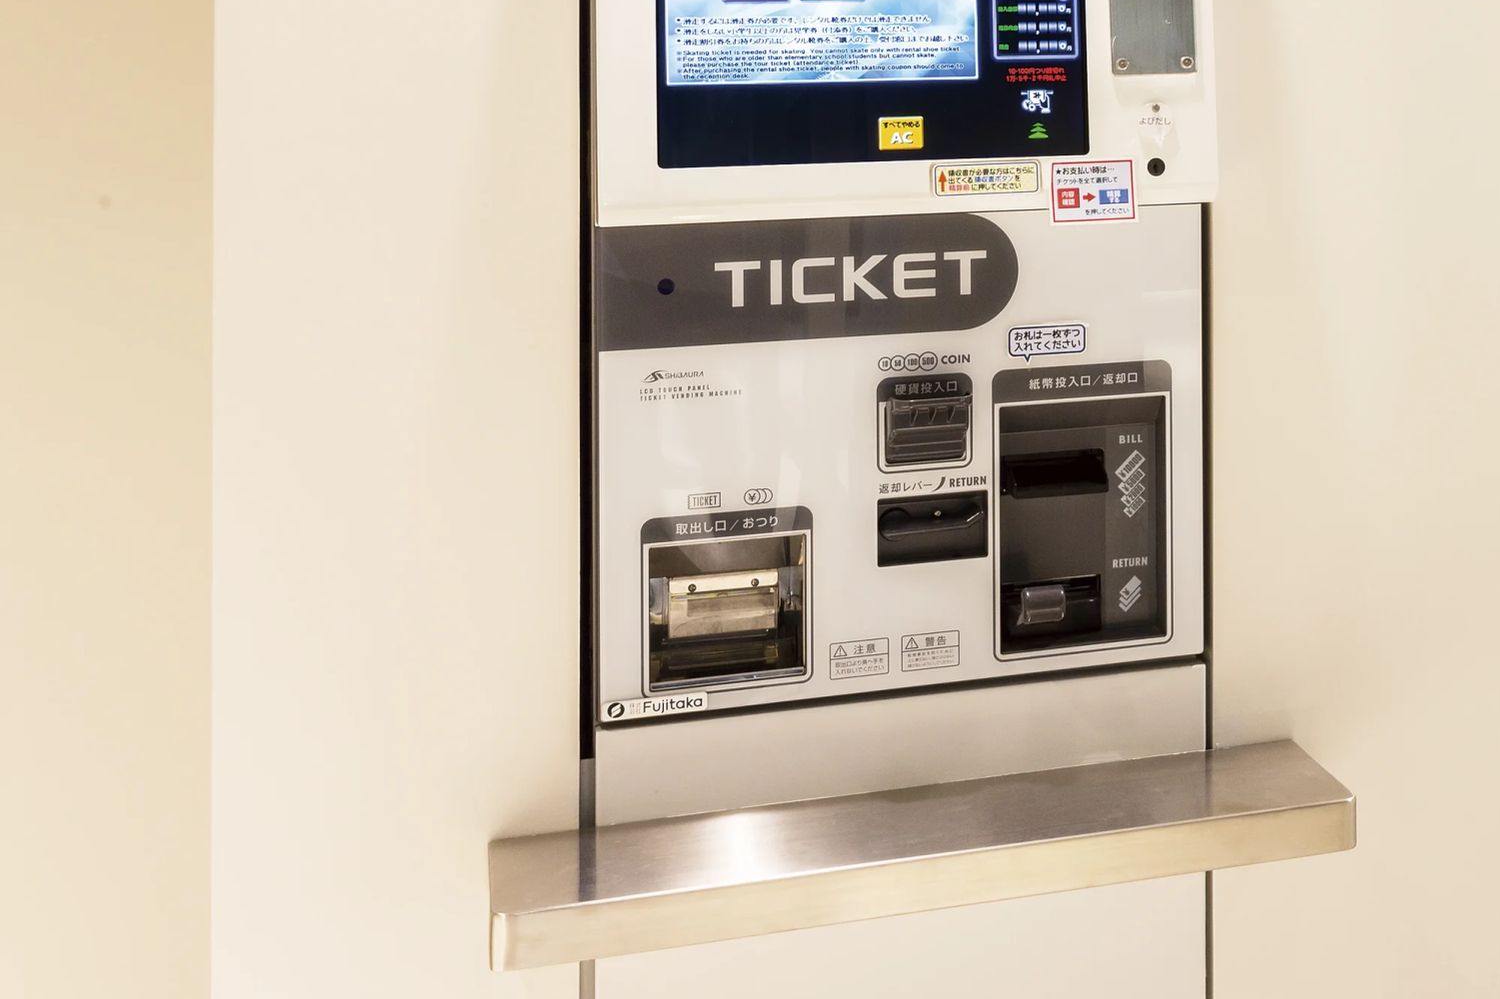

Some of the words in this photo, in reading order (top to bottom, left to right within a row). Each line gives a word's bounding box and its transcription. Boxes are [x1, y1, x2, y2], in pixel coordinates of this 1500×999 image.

[891, 132, 913, 144] AC
[714, 250, 987, 308] TICKET
[1014, 328, 1080, 341] お札は一枚ずつ
[1014, 339, 1081, 352] 入れてください
[922, 351, 937, 366] 500
[941, 353, 971, 364] COIN
[894, 380, 958, 396] 硬貨投入口
[1029, 372, 1138, 390] 紙幣投入口/返却口
[1118, 434, 1143, 444] BILL
[878, 480, 933, 494] 返却レバー
[949, 475, 987, 488] RETURN
[692, 495, 718, 507] TICKET
[1112, 556, 1148, 569] RETURN
[643, 697, 703, 713] Fujitaka
